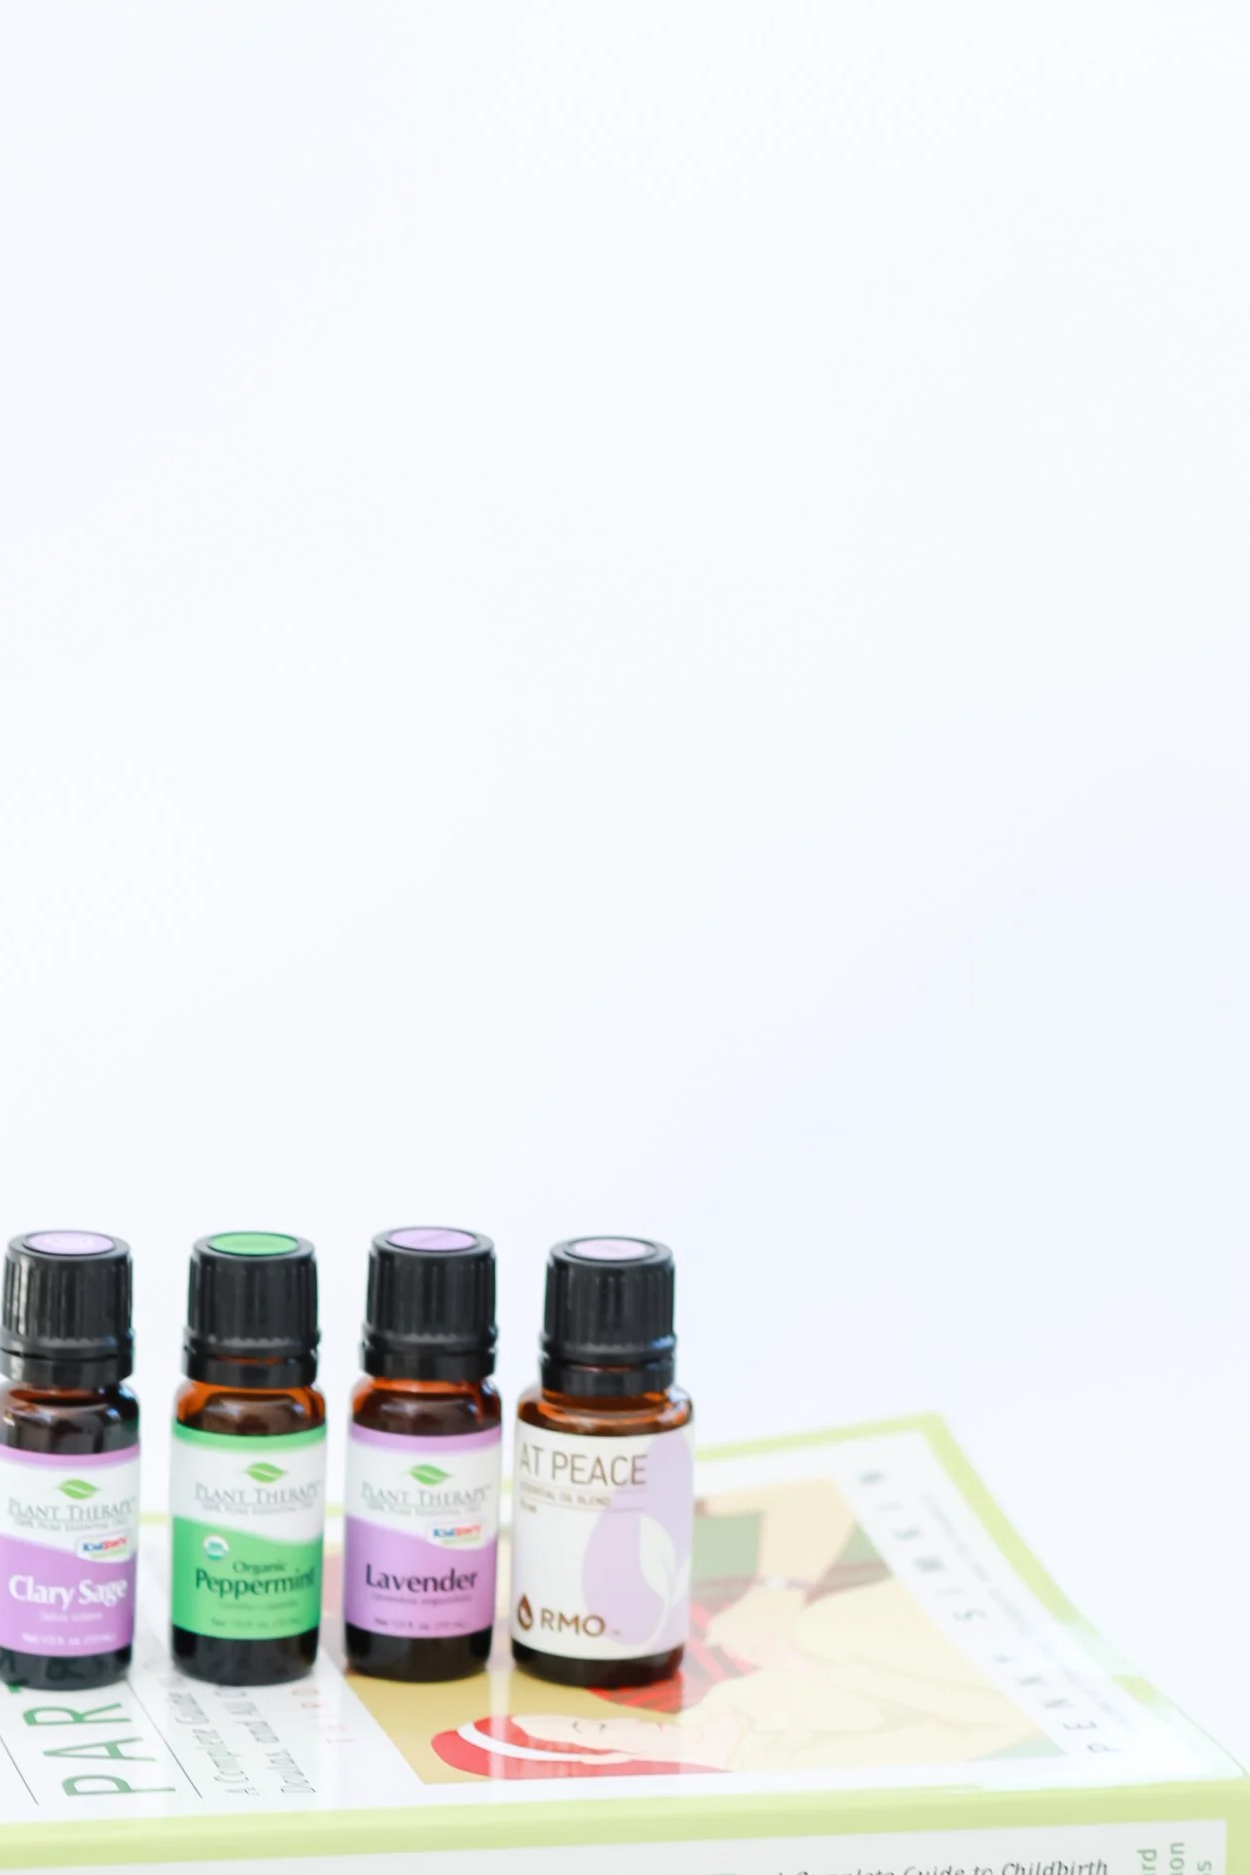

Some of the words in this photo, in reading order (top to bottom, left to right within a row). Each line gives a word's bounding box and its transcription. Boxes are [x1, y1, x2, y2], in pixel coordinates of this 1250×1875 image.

[519, 1442, 545, 1477] AT
[552, 1450, 648, 1487] PEACE
[194, 1481, 247, 1505] PLANT
[361, 1481, 411, 1505] PLANT
[8, 1496, 60, 1521] PLANT
[232, 1560, 288, 1576] Organic
[365, 1563, 479, 1593] Lavender
[8, 1574, 75, 1611] Clary
[78, 1578, 128, 1608] Sage
[195, 1567, 316, 1600] Peppermint
[540, 1607, 606, 1637] RMO
